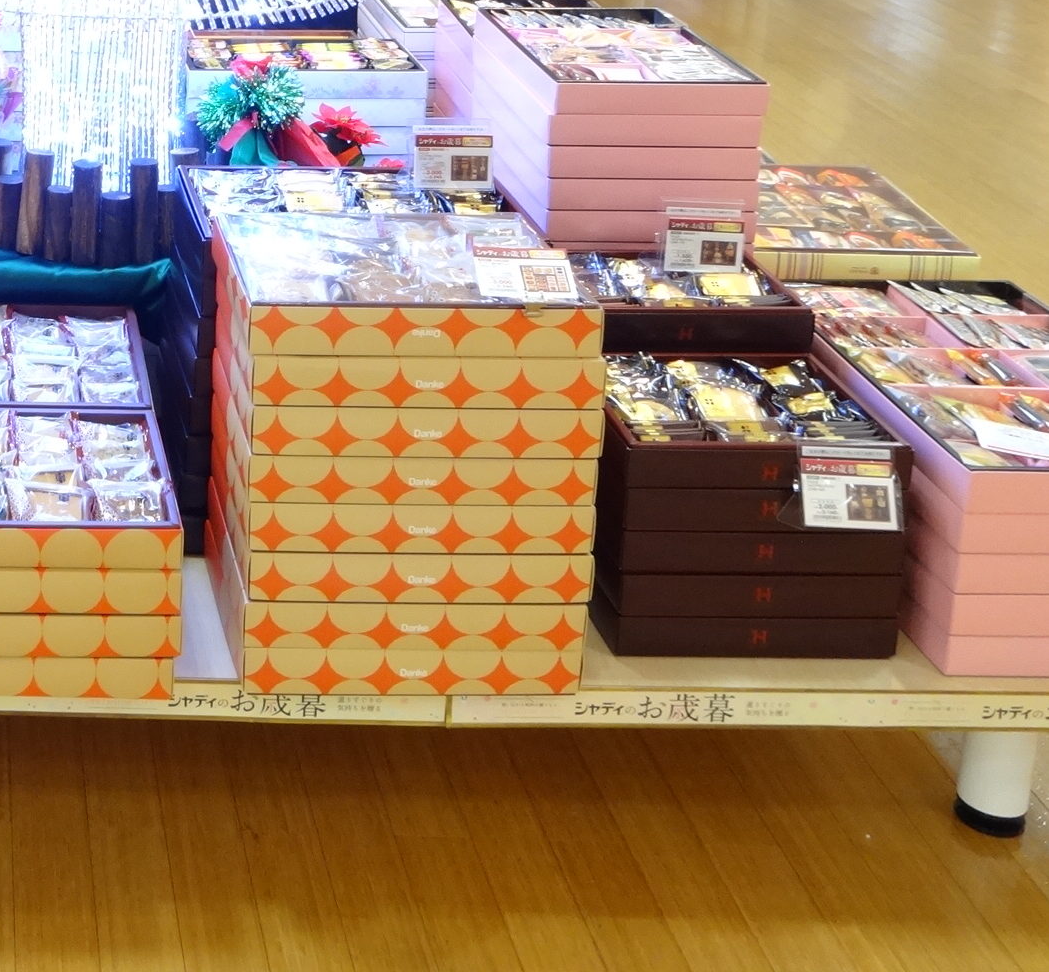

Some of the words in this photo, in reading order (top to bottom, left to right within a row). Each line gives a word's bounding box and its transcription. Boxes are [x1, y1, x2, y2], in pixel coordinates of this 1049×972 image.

[415, 380, 444, 389] Danke
[413, 429, 443, 439] Danke
[409, 477, 438, 486] Danke
[408, 526, 437, 535] Danke
[407, 575, 437, 585] Danke
[401, 623, 430, 633] Danke
[400, 668, 428, 677] Danke
[574, 694, 736, 723] シャディのお歳暮
[981, 705, 1049, 721] シャディの
